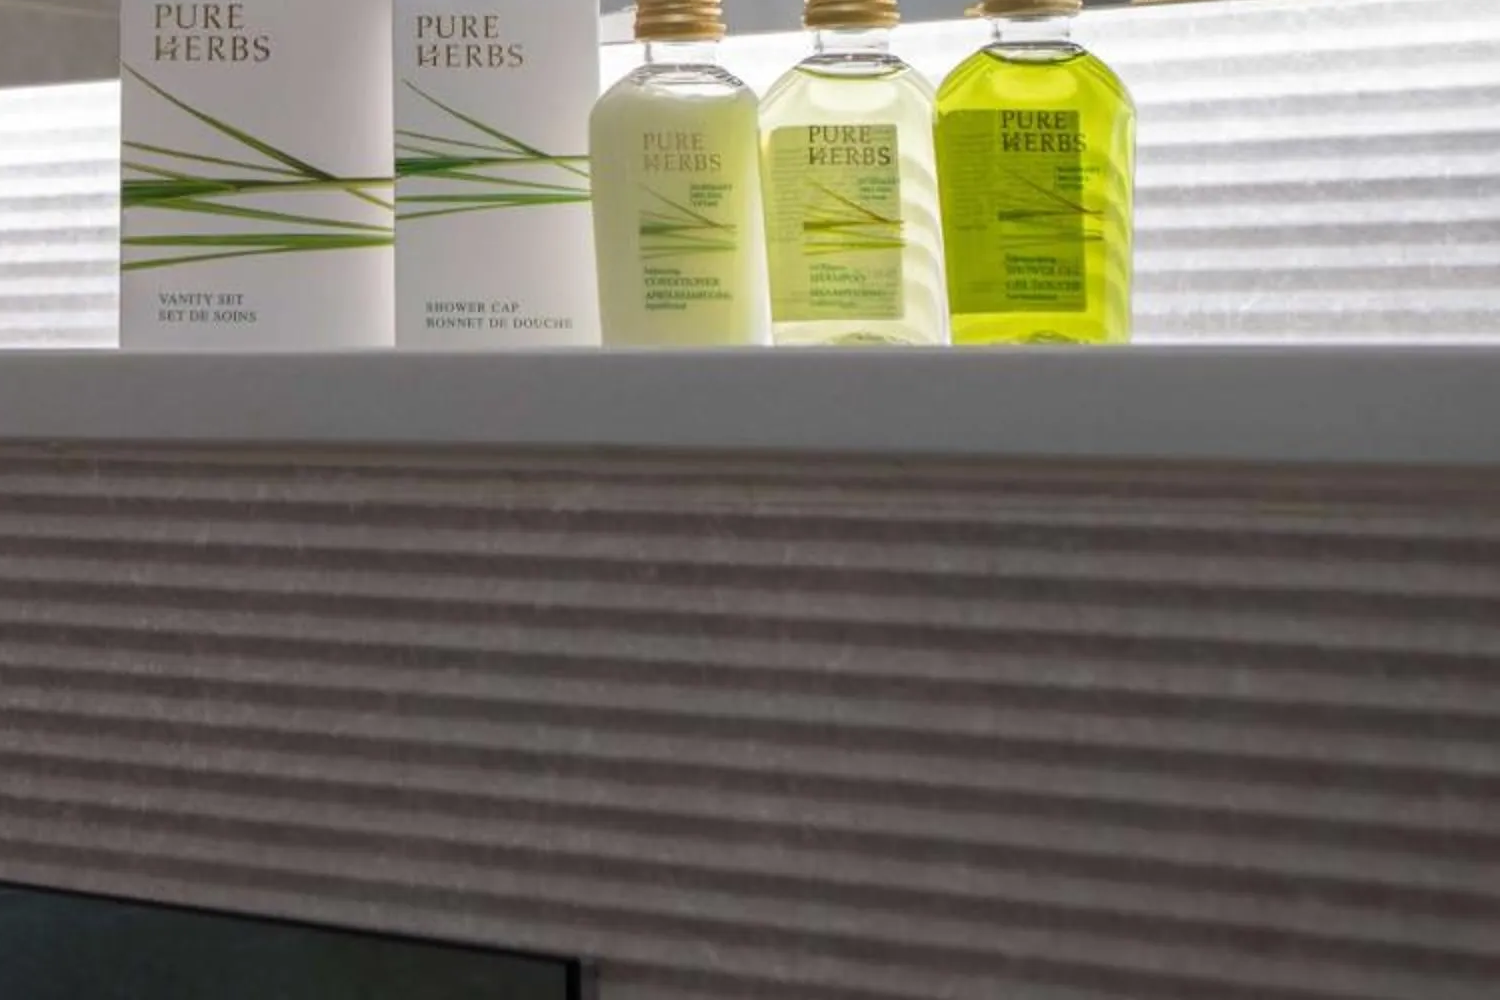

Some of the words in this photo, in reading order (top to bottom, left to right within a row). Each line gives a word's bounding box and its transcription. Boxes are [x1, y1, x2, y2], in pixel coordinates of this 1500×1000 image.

[155, 2, 245, 29] PURE
[417, 14, 500, 38] PURE
[155, 35, 271, 62] HERBS
[417, 43, 524, 68] HERBS
[1001, 109, 1067, 130] PURE
[643, 132, 706, 151] PURE
[808, 125, 872, 145] PURE
[1002, 132, 1088, 152] HERBS
[643, 153, 722, 172] HERBS
[808, 146, 891, 166] HERBS
[158, 293, 213, 306] VANITY
[217, 293, 244, 306] SET
[425, 301, 486, 314] SHOWER
[490, 301, 521, 314] CAP
[158, 309, 184, 322] SET
[188, 310, 209, 322] DE
[212, 310, 258, 323] SOINS
[425, 316, 484, 329] BONNET
[488, 317, 508, 330] DE
[512, 317, 574, 330] DOUCHE
